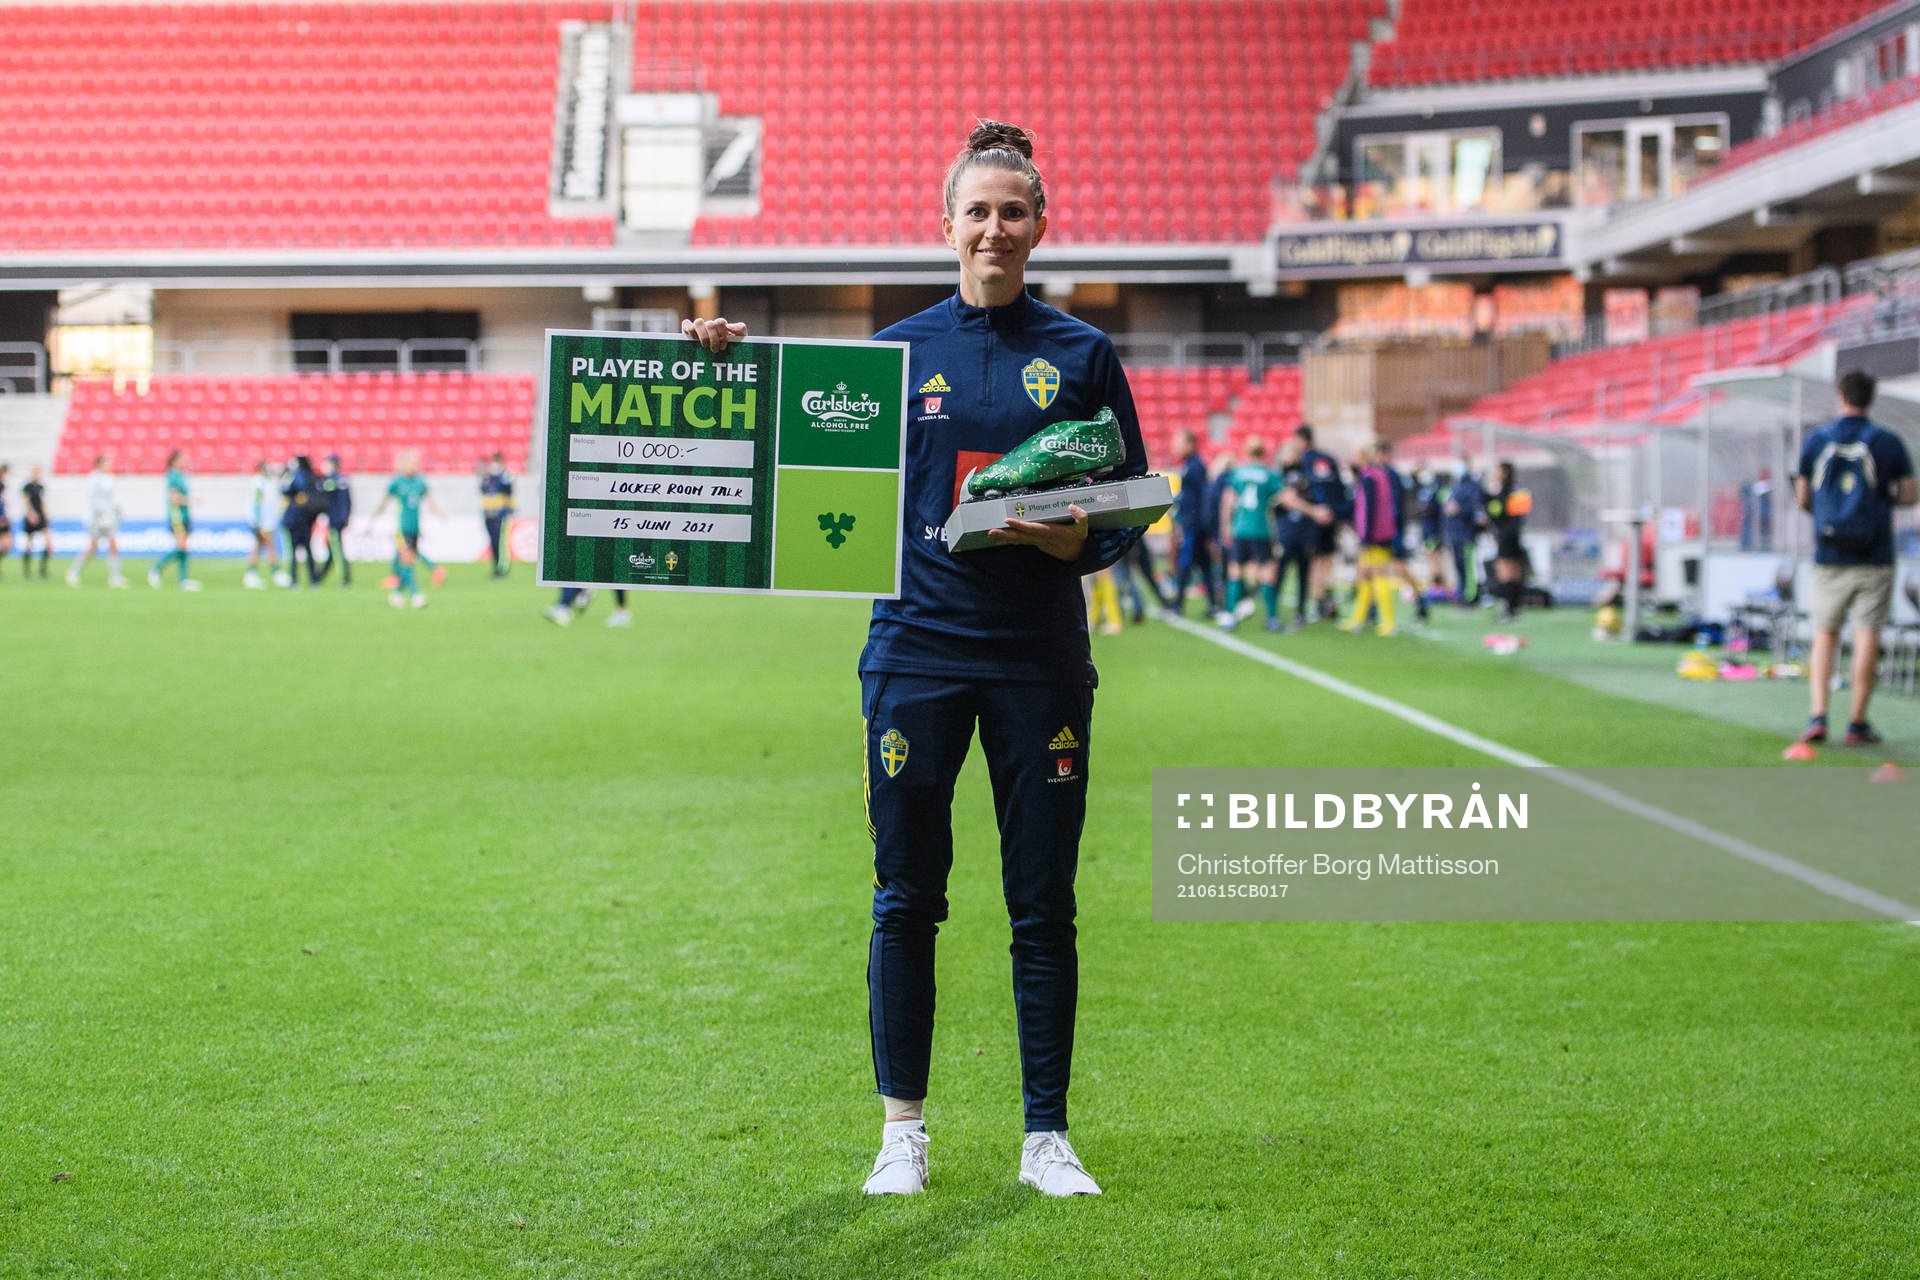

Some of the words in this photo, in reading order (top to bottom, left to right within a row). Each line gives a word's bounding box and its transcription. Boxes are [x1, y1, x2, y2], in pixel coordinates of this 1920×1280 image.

[572, 357, 664, 379] PLAYER
[671, 361, 705, 380] OF
[712, 363, 757, 382] THE
[919, 385, 951, 394] adidas
[570, 382, 757, 430] MATCH
[801, 390, 880, 420] Carlsberg
[811, 421, 848, 429] ALCOHOL
[618, 441, 634, 458] 10
[1039, 434, 1108, 460] Carlsberg
[572, 474, 600, 482] Förening
[610, 480, 661, 495] LOCKER
[667, 482, 703, 496] ROOM
[711, 485, 743, 498] TALK
[570, 511, 592, 519] Datum
[1028, 503, 1051, 512] Player
[612, 517, 631, 530] 15
[636, 519, 672, 531] JUNI
[681, 521, 714, 533] 2021
[1048, 741, 1080, 750] adidas
